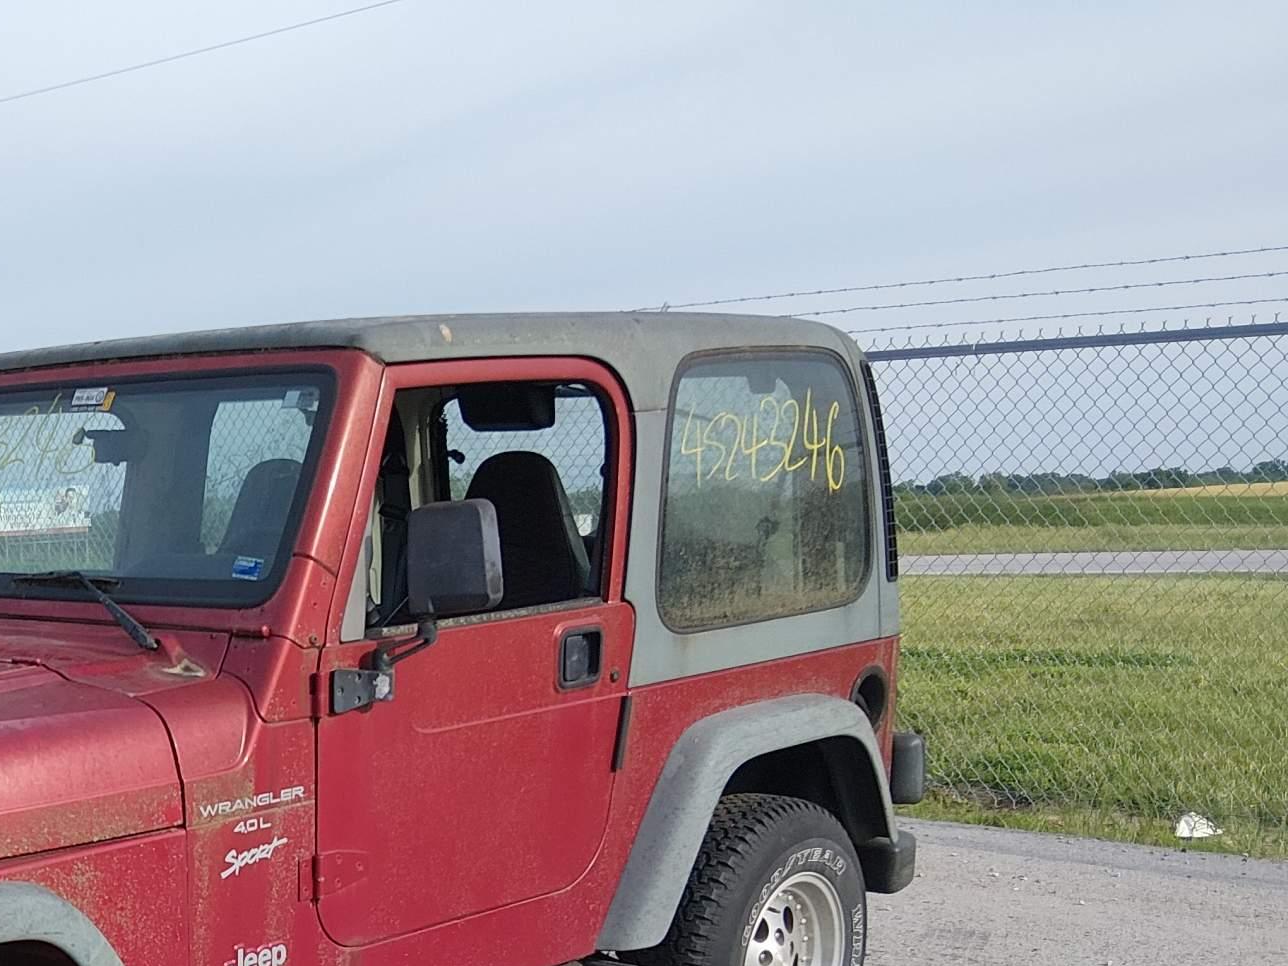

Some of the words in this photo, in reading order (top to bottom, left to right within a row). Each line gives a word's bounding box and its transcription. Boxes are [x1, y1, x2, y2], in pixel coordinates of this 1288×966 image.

[681, 385, 845, 495] 45243246
[200, 786, 304, 817] WRANGLER
[220, 836, 288, 879] Sport
